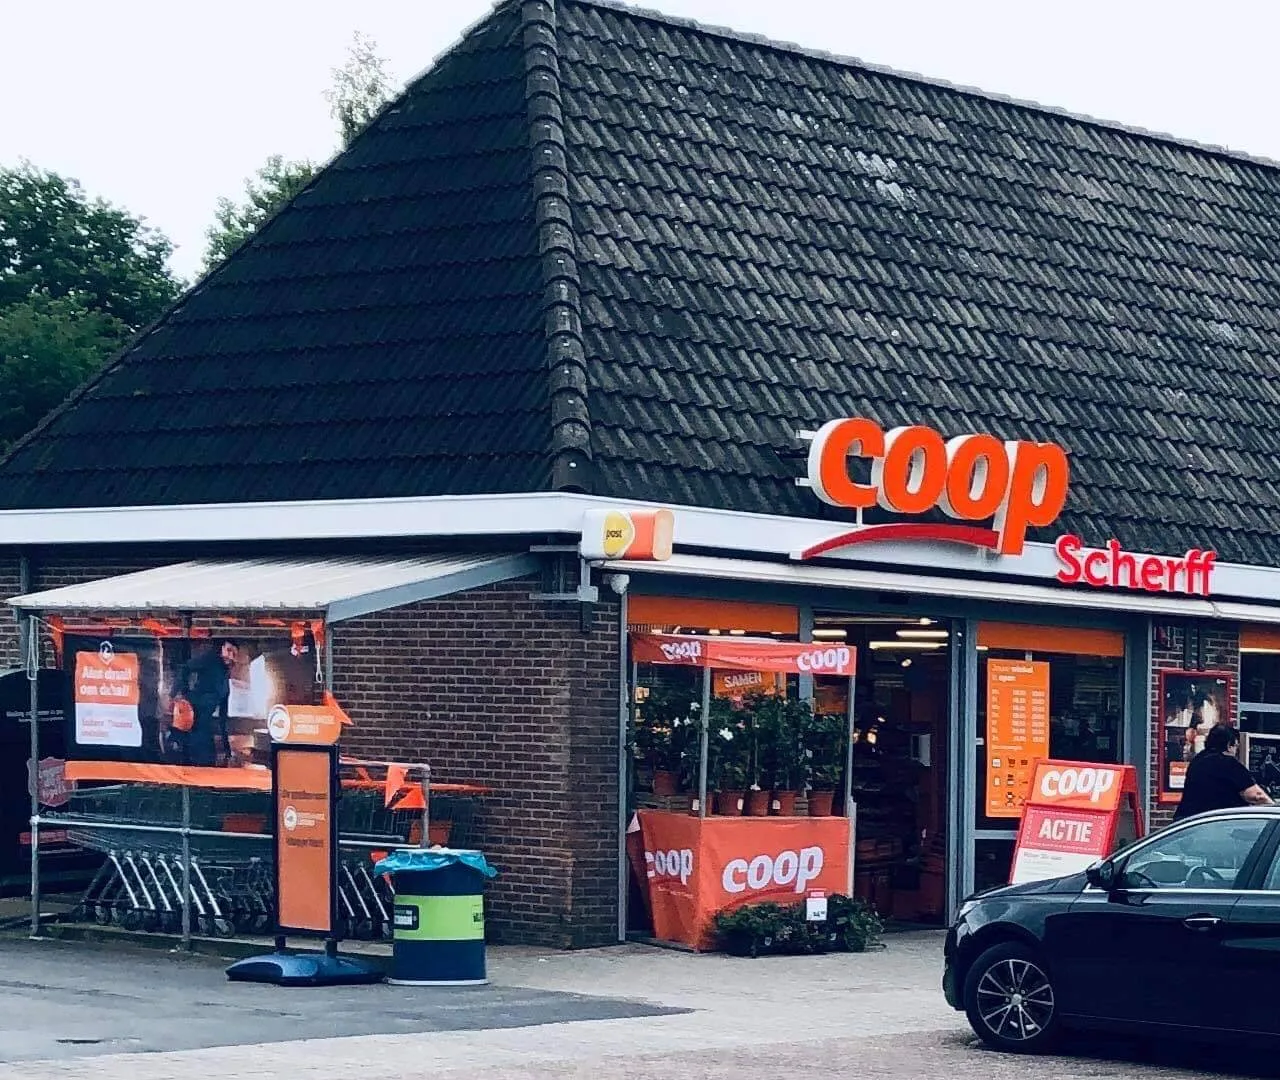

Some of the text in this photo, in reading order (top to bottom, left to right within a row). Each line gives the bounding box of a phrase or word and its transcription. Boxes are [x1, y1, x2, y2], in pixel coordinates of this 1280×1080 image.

[809, 416, 1069, 556] coop
[606, 530, 622, 540] post
[1055, 534, 1217, 596] Scherff
[660, 640, 702, 664] coop
[797, 647, 849, 673] coop
[724, 671, 762, 688] SAMEN
[1041, 767, 1115, 803] coop
[1038, 817, 1094, 843] ACTIE
[722, 845, 824, 893] coop
